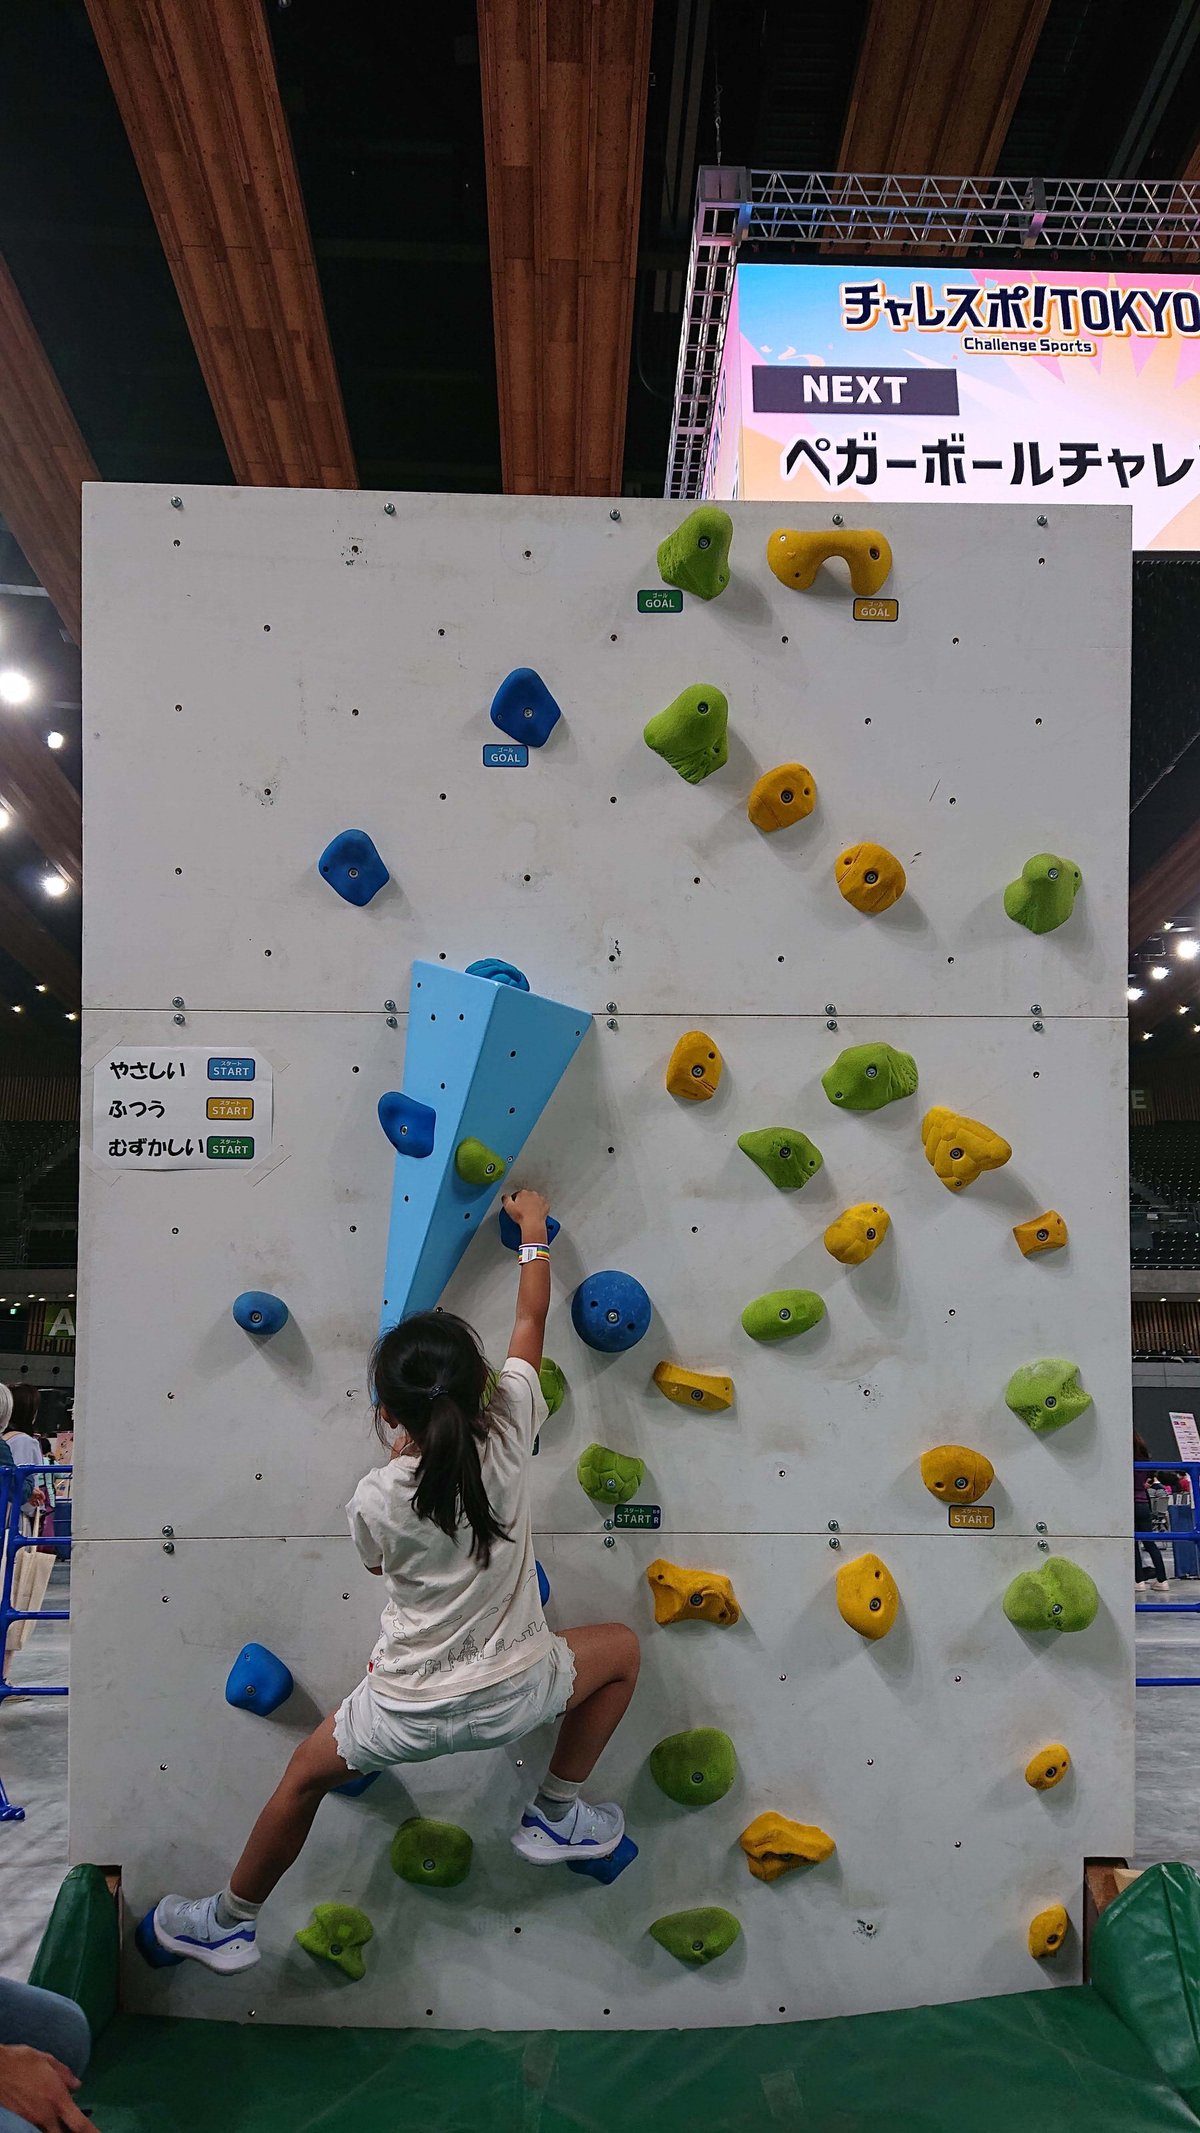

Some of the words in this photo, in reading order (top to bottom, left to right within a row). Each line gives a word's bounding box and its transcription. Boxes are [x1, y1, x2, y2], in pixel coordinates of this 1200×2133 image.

[964, 337, 1037, 352] Challenge
[1040, 338, 1092, 353] Sports
[803, 374, 908, 404] NEXT
[786, 432, 1200, 488] ペガーボールチャレ
[645, 599, 675, 608] GOAL
[861, 607, 890, 617] GOAL
[491, 753, 521, 763] GOAL
[109, 1061, 186, 1080] やさしい
[213, 1066, 250, 1076] START
[108, 1100, 166, 1119] ふつう
[212, 1106, 249, 1116] START
[108, 1137, 204, 1157] むずかしい
[212, 1145, 249, 1155] START
[48, 1308, 76, 1336] A
[616, 1514, 651, 1524] START
[954, 1515, 990, 1524] START
